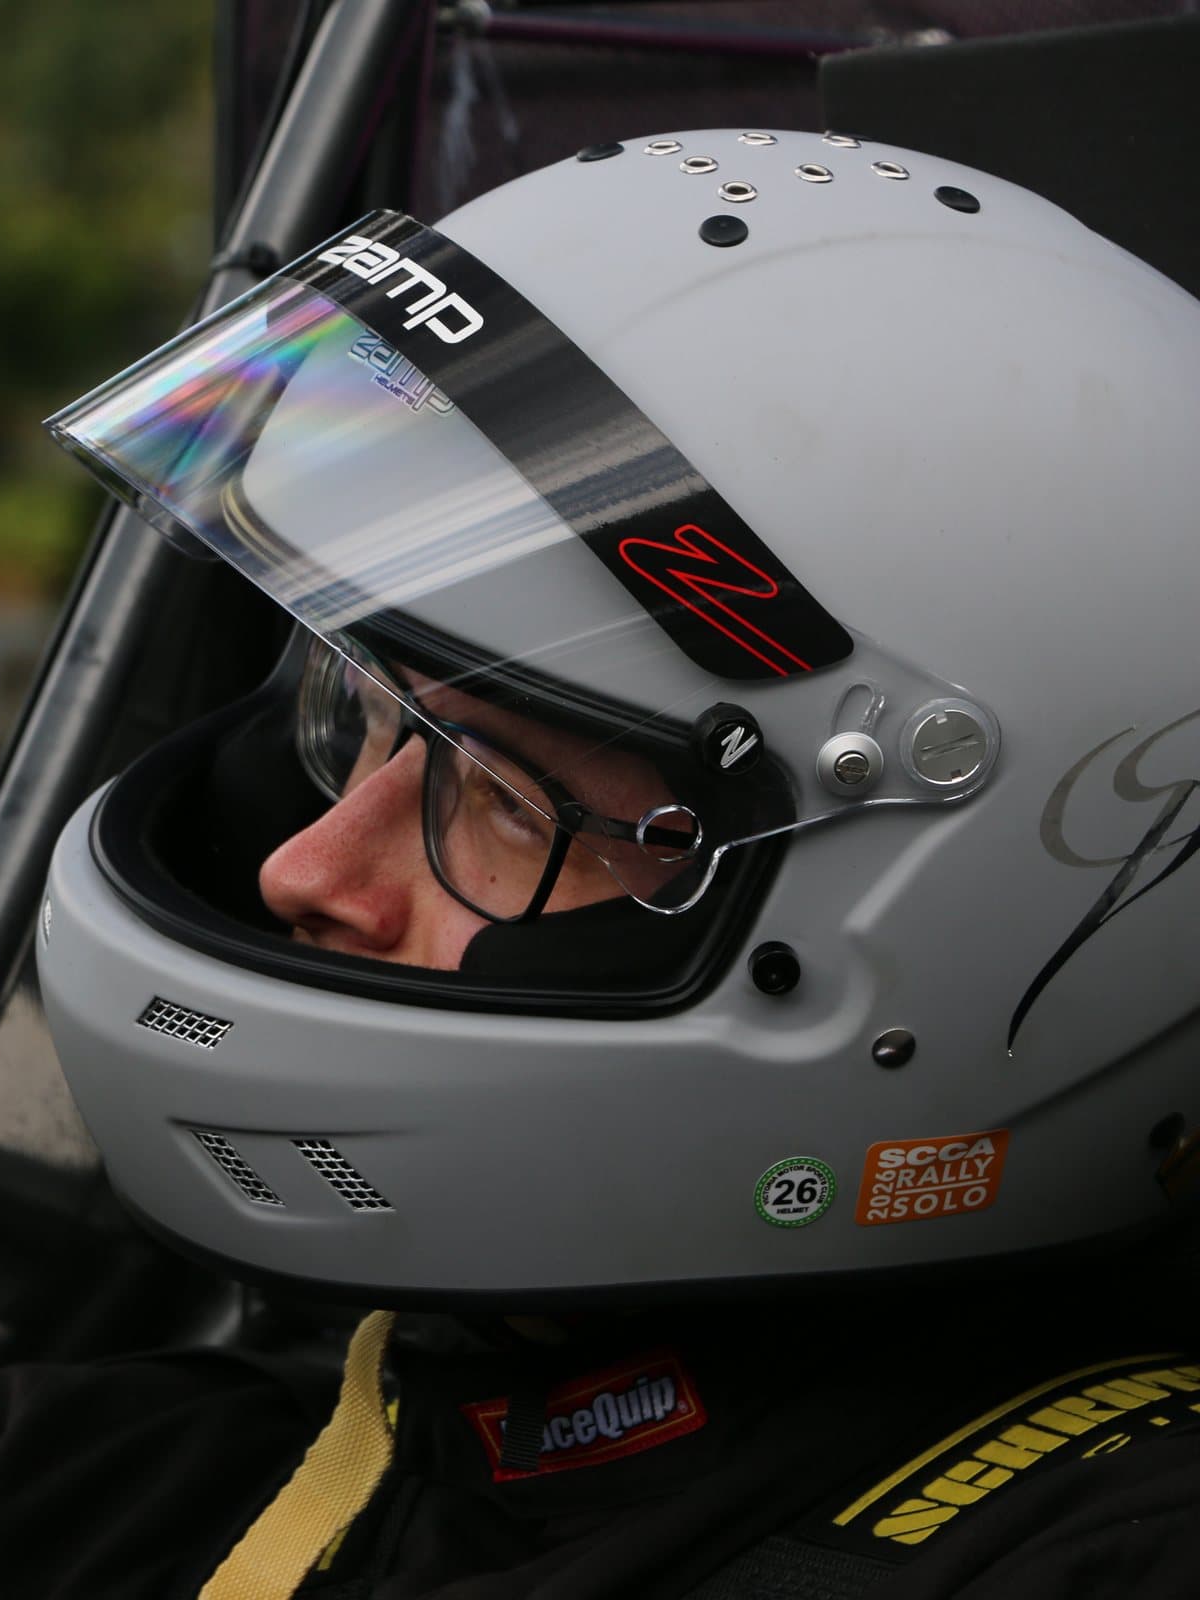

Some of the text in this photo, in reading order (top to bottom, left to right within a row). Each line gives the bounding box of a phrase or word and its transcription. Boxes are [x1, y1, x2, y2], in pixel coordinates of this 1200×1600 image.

[316, 235, 485, 344] zamp
[878, 1136, 996, 1169] SCCA
[777, 1164, 805, 1178] MOTOR
[805, 1166, 827, 1186] SPORTS
[895, 1155, 995, 1189] RALLY
[772, 1178, 818, 1206] 26
[866, 1169, 895, 1221] 2026
[890, 1184, 988, 1218] SOLO
[776, 1206, 810, 1215] HELMET
